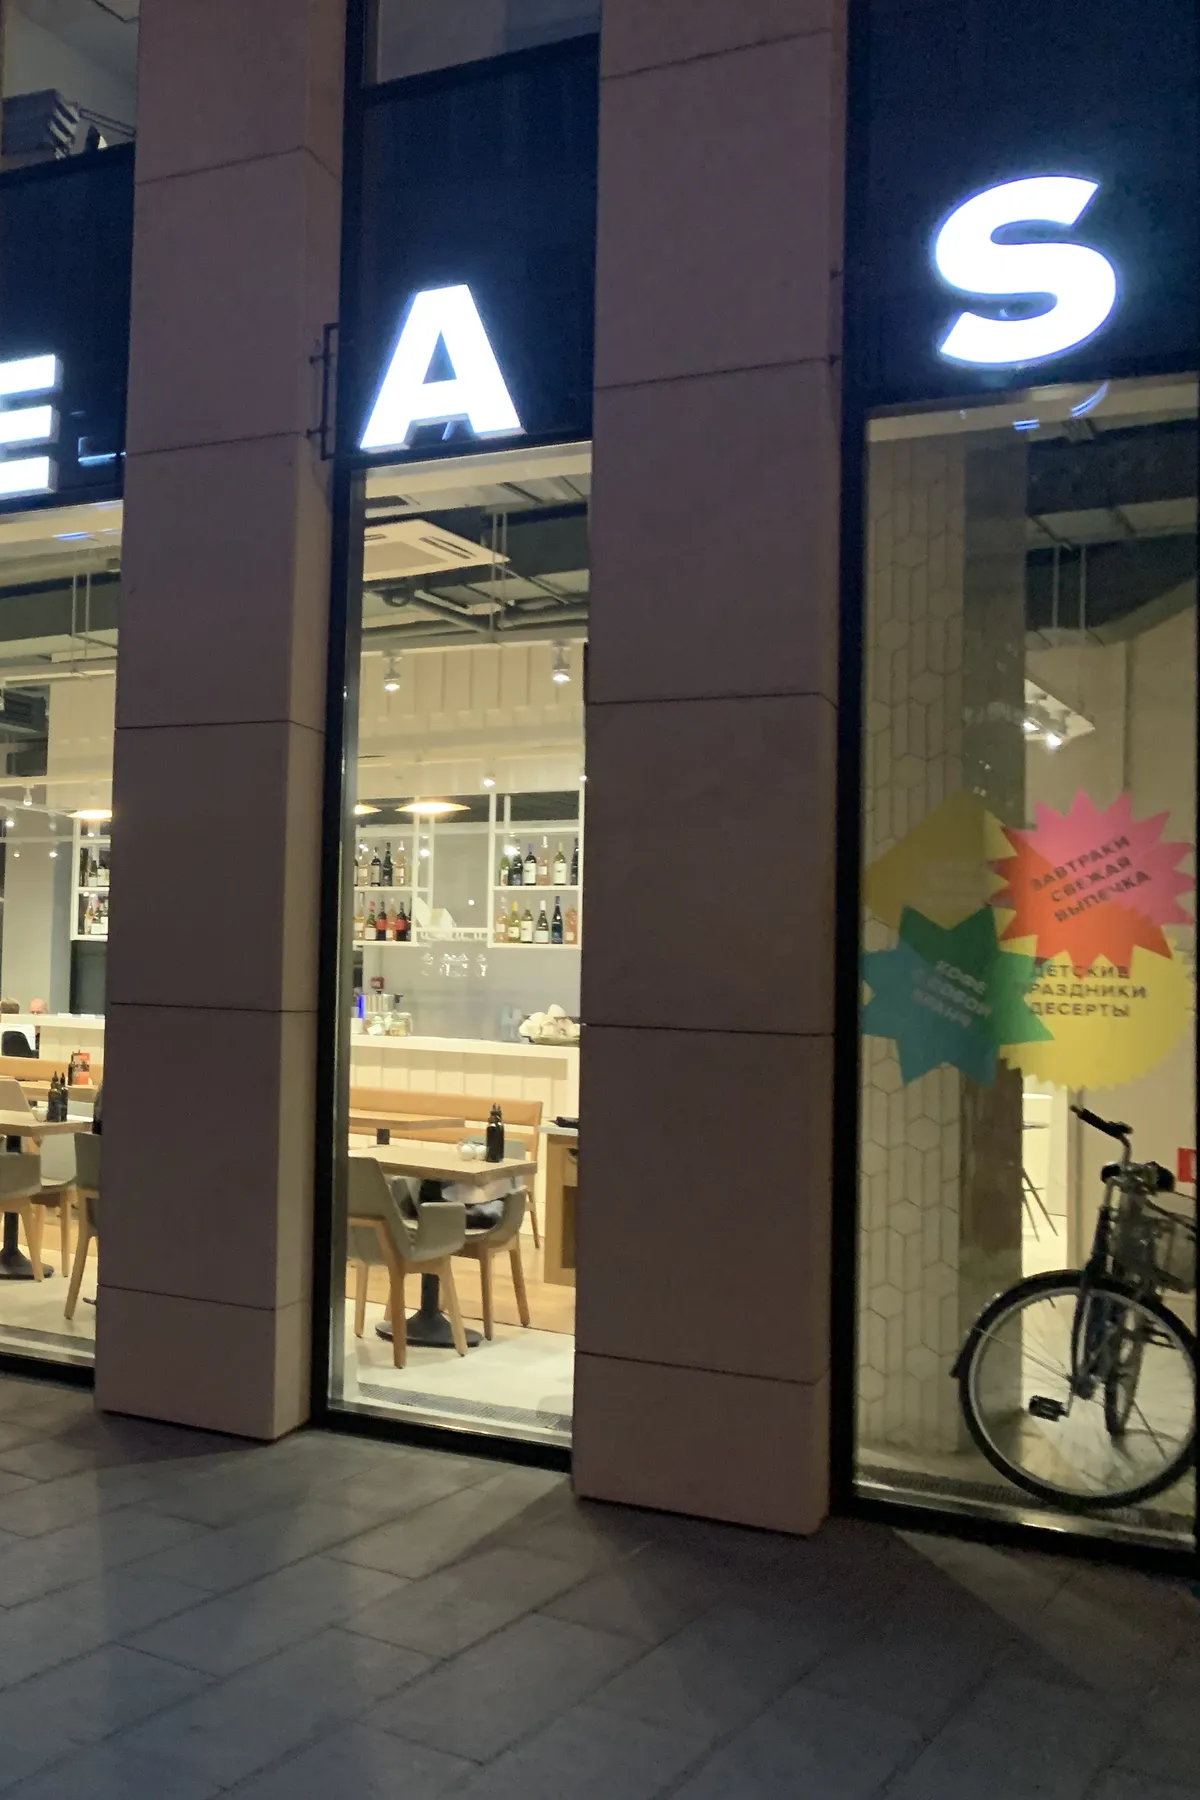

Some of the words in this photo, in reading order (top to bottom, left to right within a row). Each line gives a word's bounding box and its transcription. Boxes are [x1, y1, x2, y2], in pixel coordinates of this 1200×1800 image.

[1030, 835, 1130, 891] ЗАВТРАКИ
[1051, 856, 1132, 902] СВЕЖАЯ
[1054, 871, 1151, 922] ВЫПЕЧКА
[1031, 964, 1131, 979] ДЕТСКИЕ
[1029, 1002, 1131, 1017] ДЕСЕРТЫ
